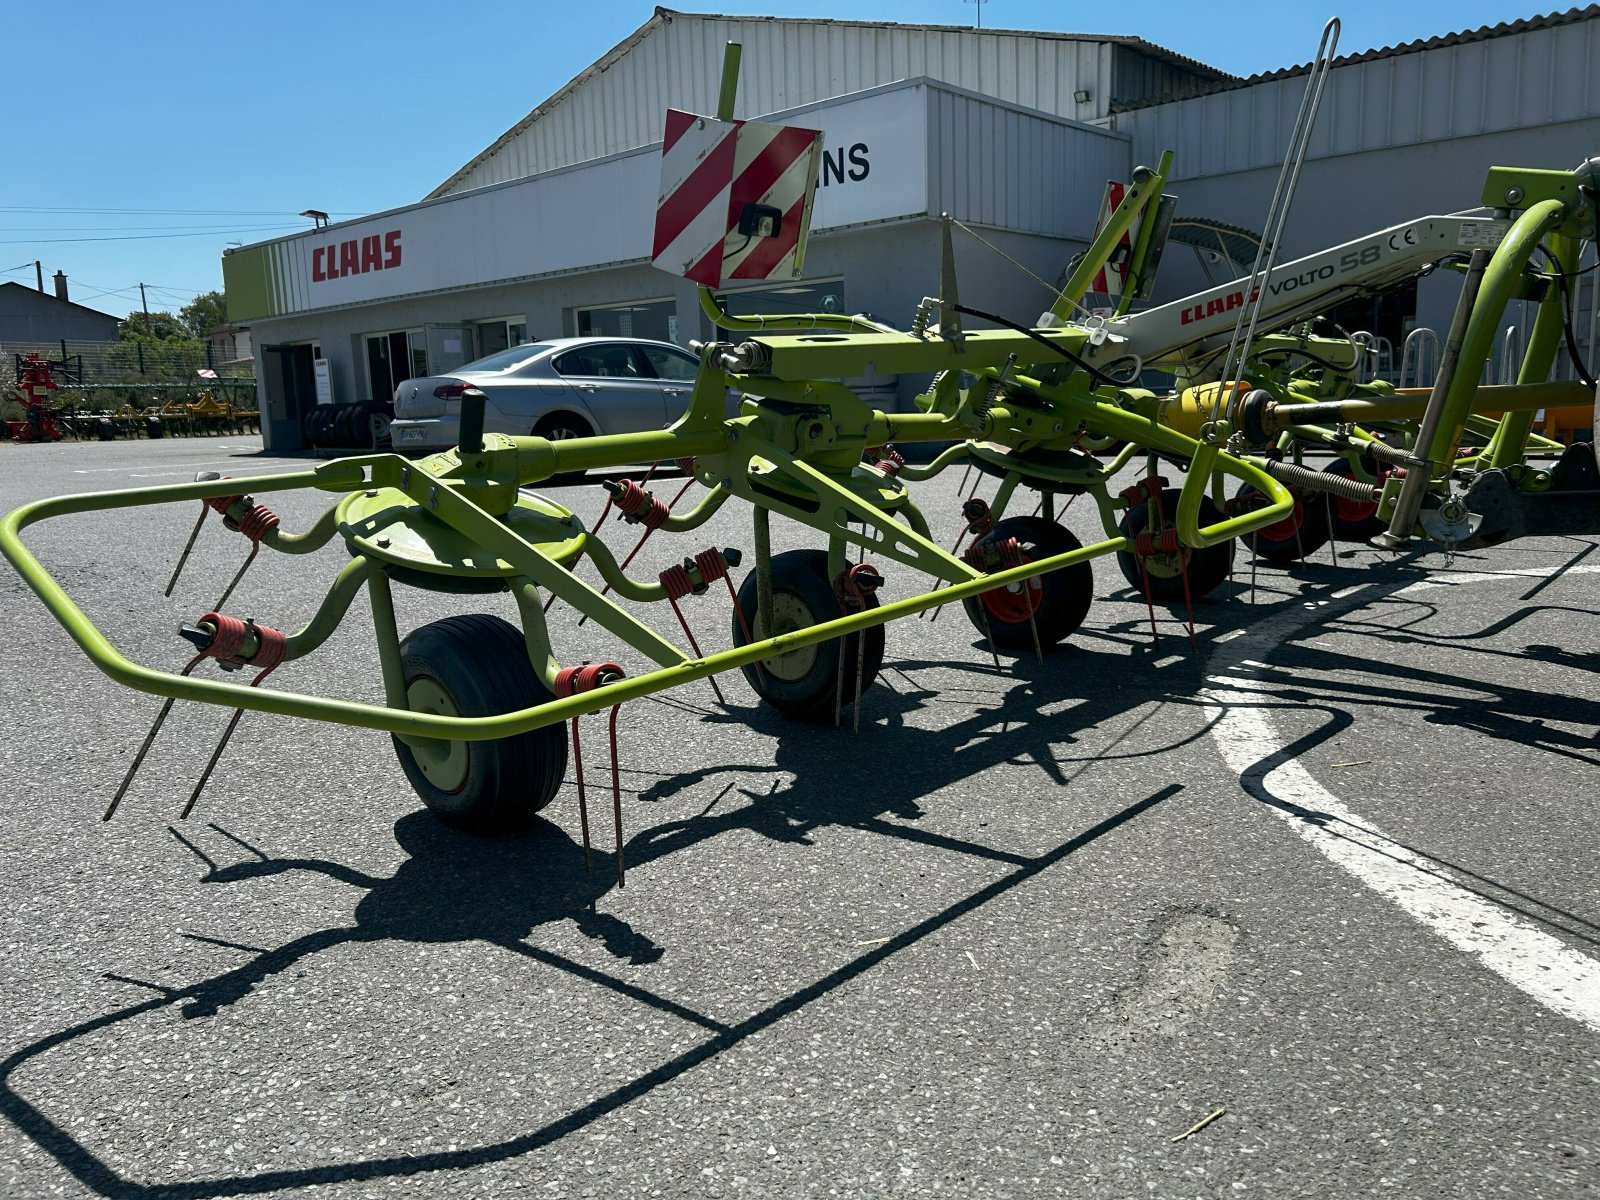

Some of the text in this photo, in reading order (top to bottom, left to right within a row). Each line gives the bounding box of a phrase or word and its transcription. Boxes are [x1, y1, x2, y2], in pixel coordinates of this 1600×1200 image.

[815, 142, 870, 188] NS
[312, 229, 402, 283] CLAAS
[1269, 265, 1335, 296] VOLTO
[1340, 245, 1381, 273] 58
